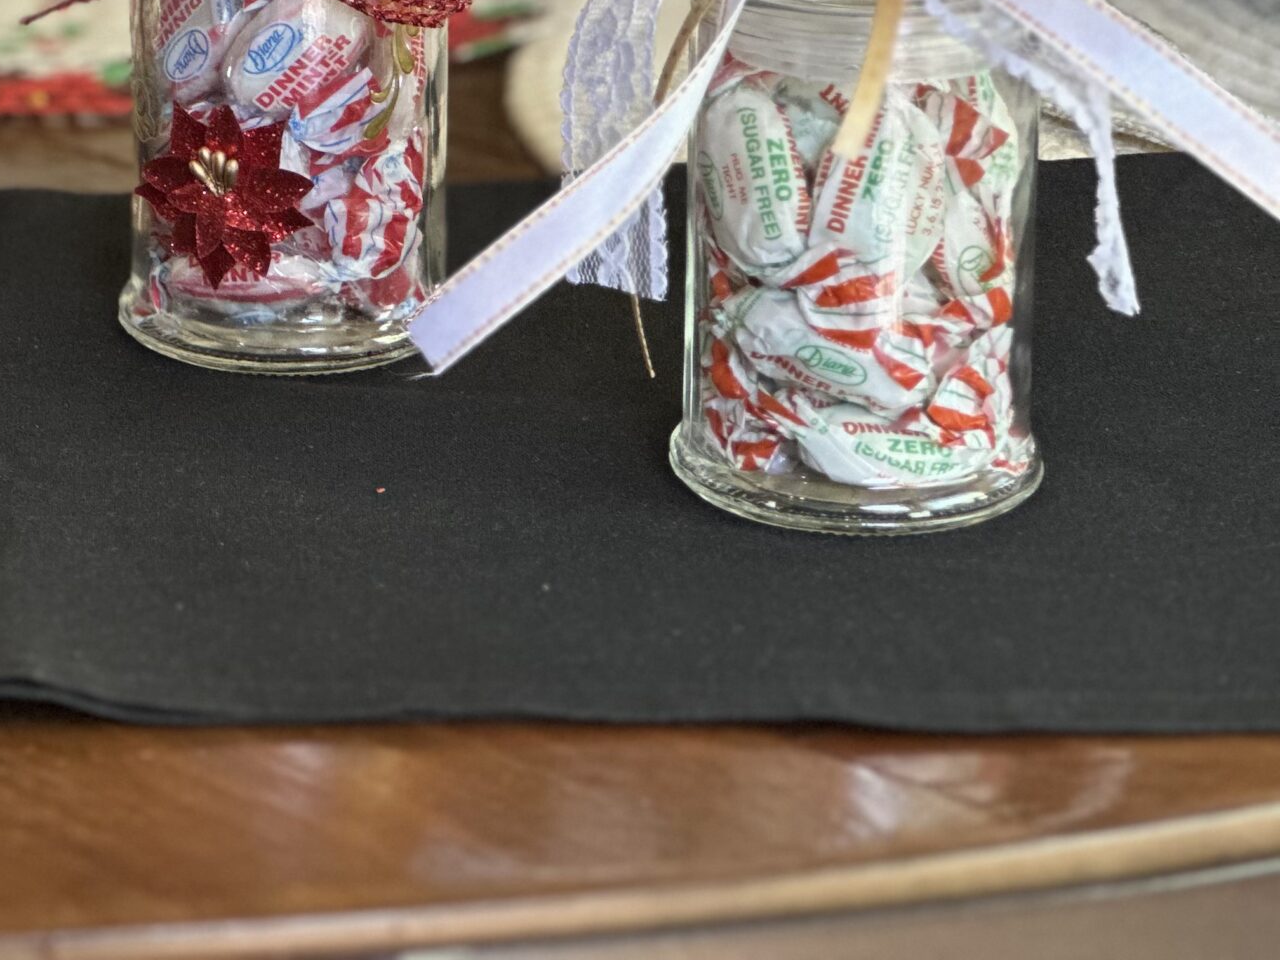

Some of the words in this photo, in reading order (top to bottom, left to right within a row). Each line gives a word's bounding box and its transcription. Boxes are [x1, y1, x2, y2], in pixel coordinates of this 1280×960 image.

[248, 28, 285, 72] Diana
[255, 34, 333, 108] DINNER
[736, 107, 766, 180] (SUGAR
[754, 184, 783, 241] FREE)
[766, 138, 793, 202] ZERO
[805, 347, 858, 377] Diana
